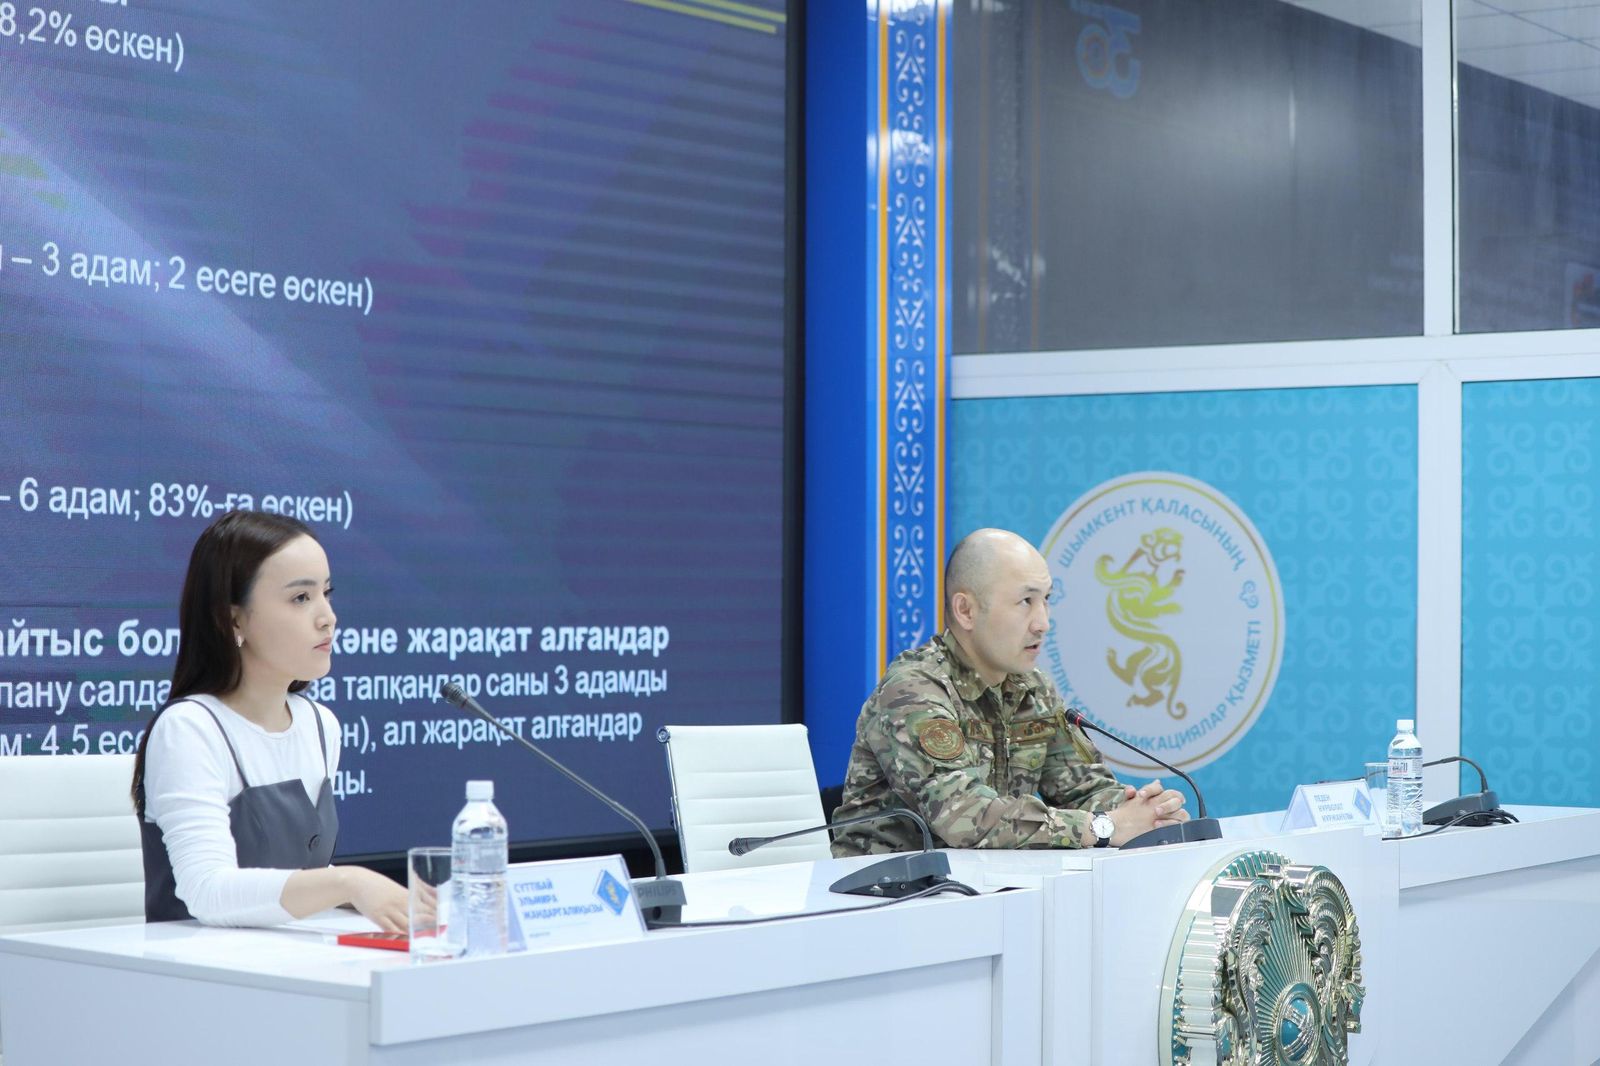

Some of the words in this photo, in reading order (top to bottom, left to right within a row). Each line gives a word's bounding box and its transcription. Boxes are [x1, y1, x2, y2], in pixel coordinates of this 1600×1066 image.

[85, 25, 184, 72] өскен)
[42, 241, 60, 276] 3
[70, 251, 161, 293] адам;
[168, 256, 186, 289] 2
[196, 266, 276, 299] есеге
[283, 275, 373, 315] өскен)
[19, 477, 39, 512] 6
[49, 484, 140, 520] адам;
[1059, 500, 1137, 568] ШЫМКЕНТ
[1141, 497, 1246, 572] ҚАЛАСЫНЫҢ
[0, 618, 104, 657] йтыс
[118, 618, 181, 657] бол
[407, 626, 533, 661] жарақат
[540, 625, 670, 657] алғандар
[79, 679, 172, 712] салда
[306, 676, 336, 701] за
[486, 672, 548, 697] саны
[554, 664, 570, 695] 3
[575, 668, 667, 699] адамды
[1224, 619, 1262, 718] ҚЫЗМЕТІ
[341, 715, 378, 753] н),
[383, 720, 416, 746] ал
[422, 718, 527, 750] жарақат
[531, 711, 643, 743] алғандар
[332, 769, 373, 801] ды.
